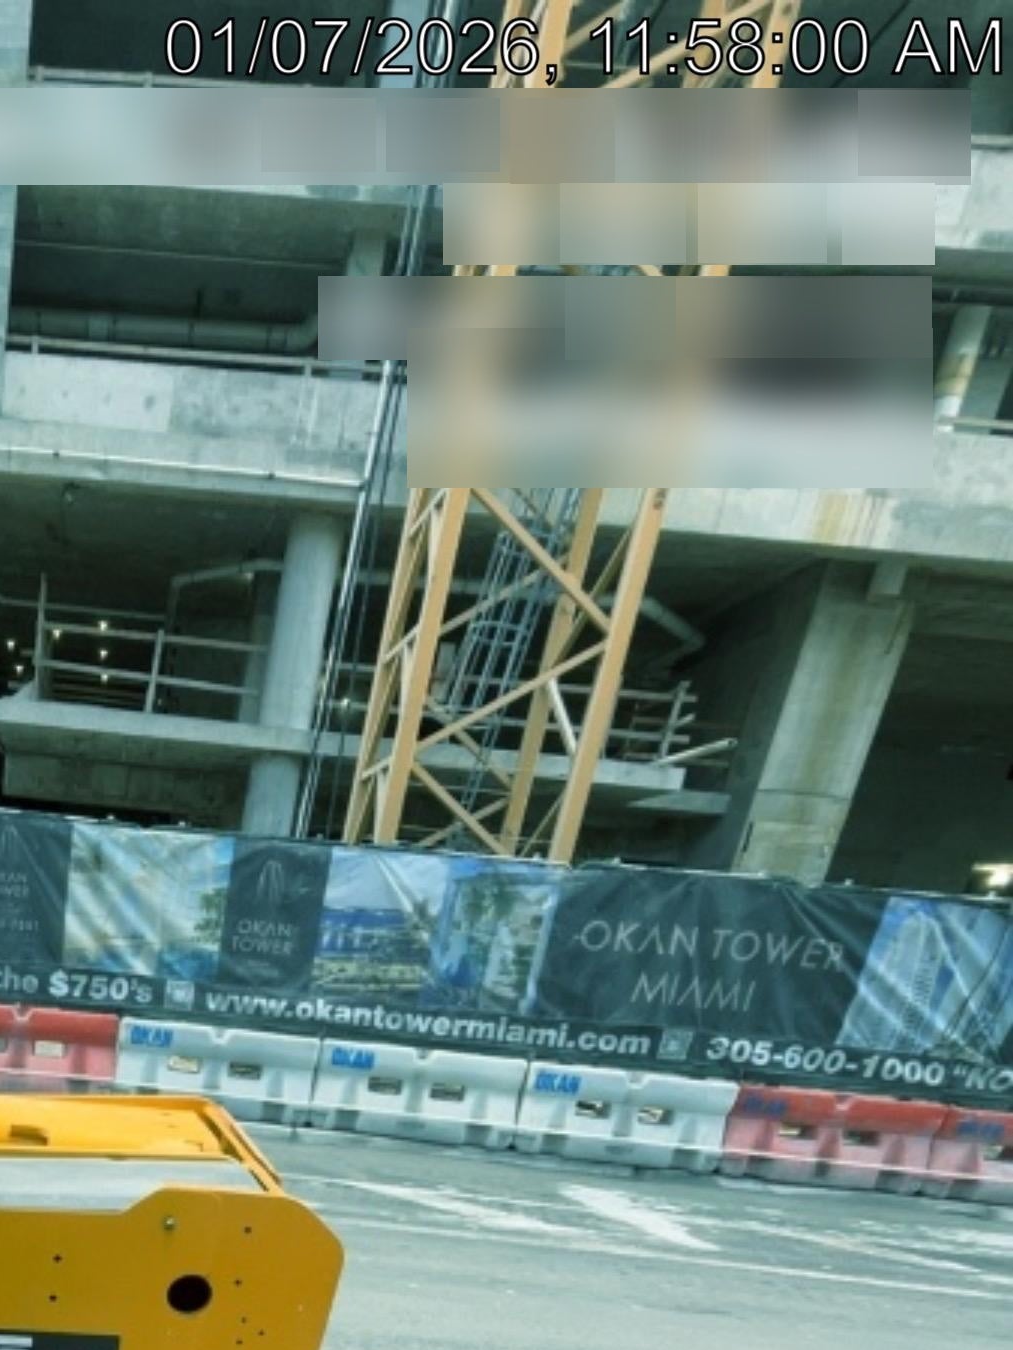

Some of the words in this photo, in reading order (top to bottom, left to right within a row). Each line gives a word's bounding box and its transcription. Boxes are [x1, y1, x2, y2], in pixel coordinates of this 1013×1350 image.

[237, 918, 292, 937] OKAN
[580, 920, 699, 957] OKAN
[711, 929, 843, 970] TOWER
[630, 971, 756, 1012] MIAMI
[206, 989, 652, 1056] www.okantowermiami.com
[706, 1036, 945, 1087] 305-600-1000
